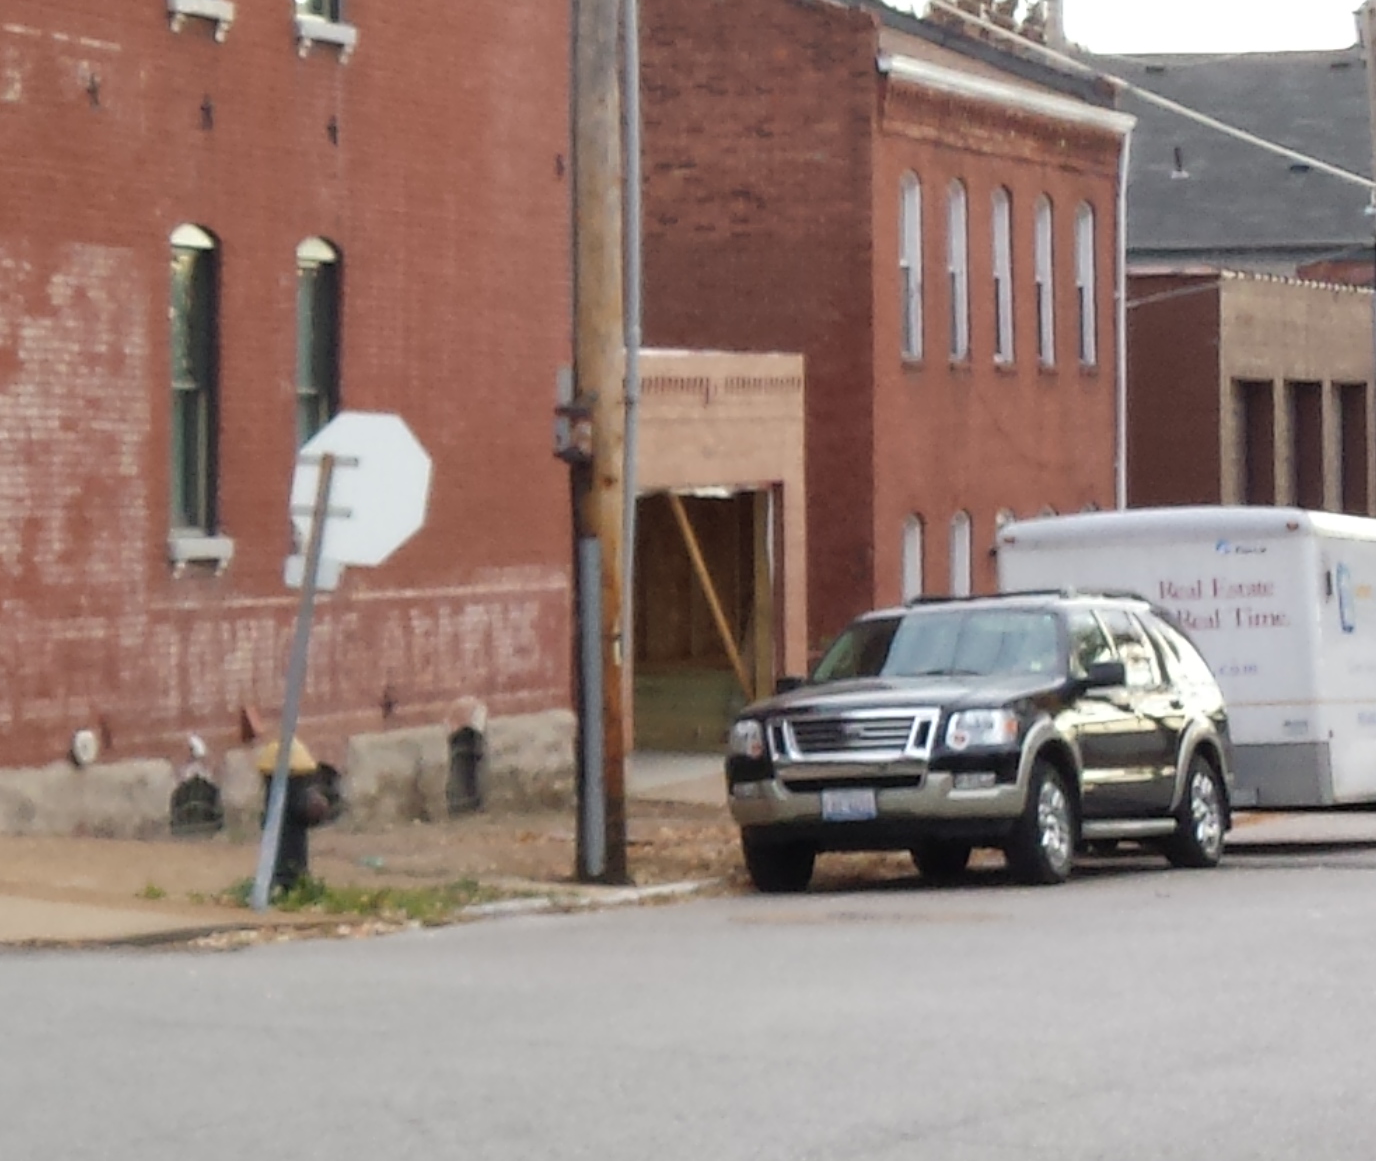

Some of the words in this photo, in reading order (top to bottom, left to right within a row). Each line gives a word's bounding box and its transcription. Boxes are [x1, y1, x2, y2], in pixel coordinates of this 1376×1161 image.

[1159, 579, 1202, 600] Real
[1211, 577, 1274, 599] Estate
[1176, 608, 1220, 631] Real
